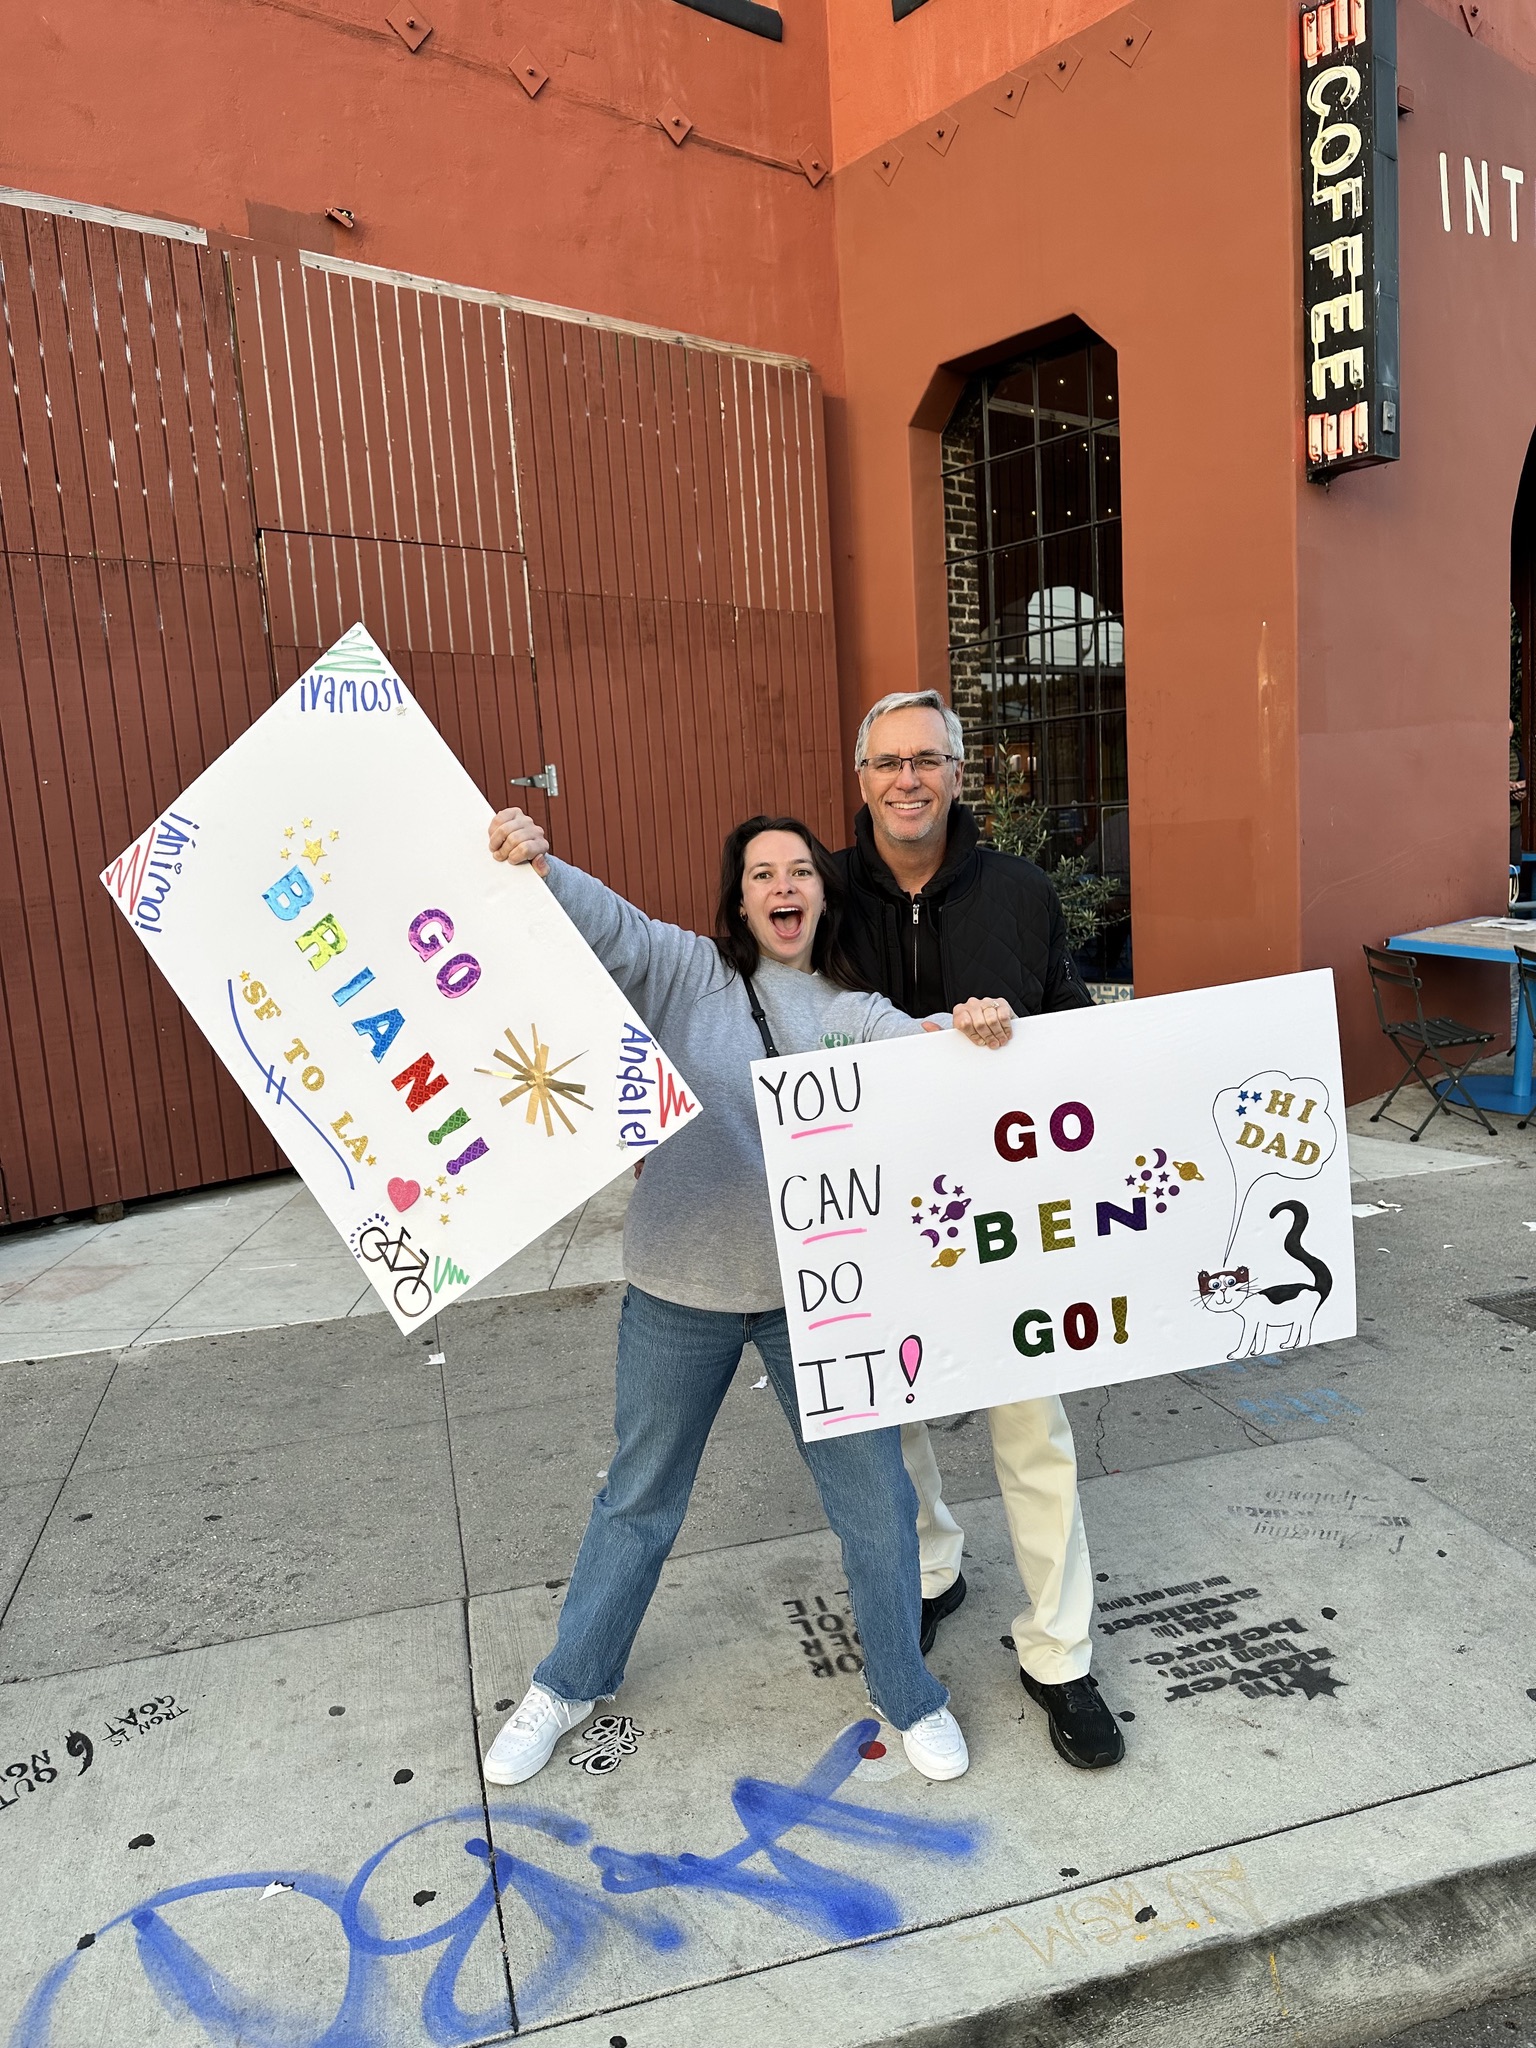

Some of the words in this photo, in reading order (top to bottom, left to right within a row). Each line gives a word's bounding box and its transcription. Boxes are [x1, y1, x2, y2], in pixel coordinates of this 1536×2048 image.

[1439, 152, 1524, 243] INT
[1306, 65, 1364, 401] COFFEE
[408, 907, 482, 999] GO
[261, 864, 489, 1175] BRIAN!!
[241, 979, 282, 1022] SF
[283, 1037, 326, 1092] TO
[329, 1111, 371, 1164] LA
[758, 1062, 862, 1126] YOU
[994, 1101, 1095, 1162] GO
[1264, 1089, 1318, 1124] HI
[1236, 1121, 1321, 1166] DAD
[780, 1164, 881, 1231] CAN
[973, 1196, 1149, 1264] BEN
[798, 1261, 863, 1313] DO
[1012, 1296, 1129, 1358] GO!
[799, 1334, 923, 1416] IT!
[1097, 1597, 1135, 1612] now
[1097, 1588, 1262, 1635] architect
[1133, 1590, 1165, 1605] out
[1164, 1647, 1336, 1702] never
[1230, 1638, 1301, 1663] been
[101, 1695, 175, 1741] GOAT
[139, 1706, 189, 1735] TRON
[0, 1750, 51, 1783] NO
